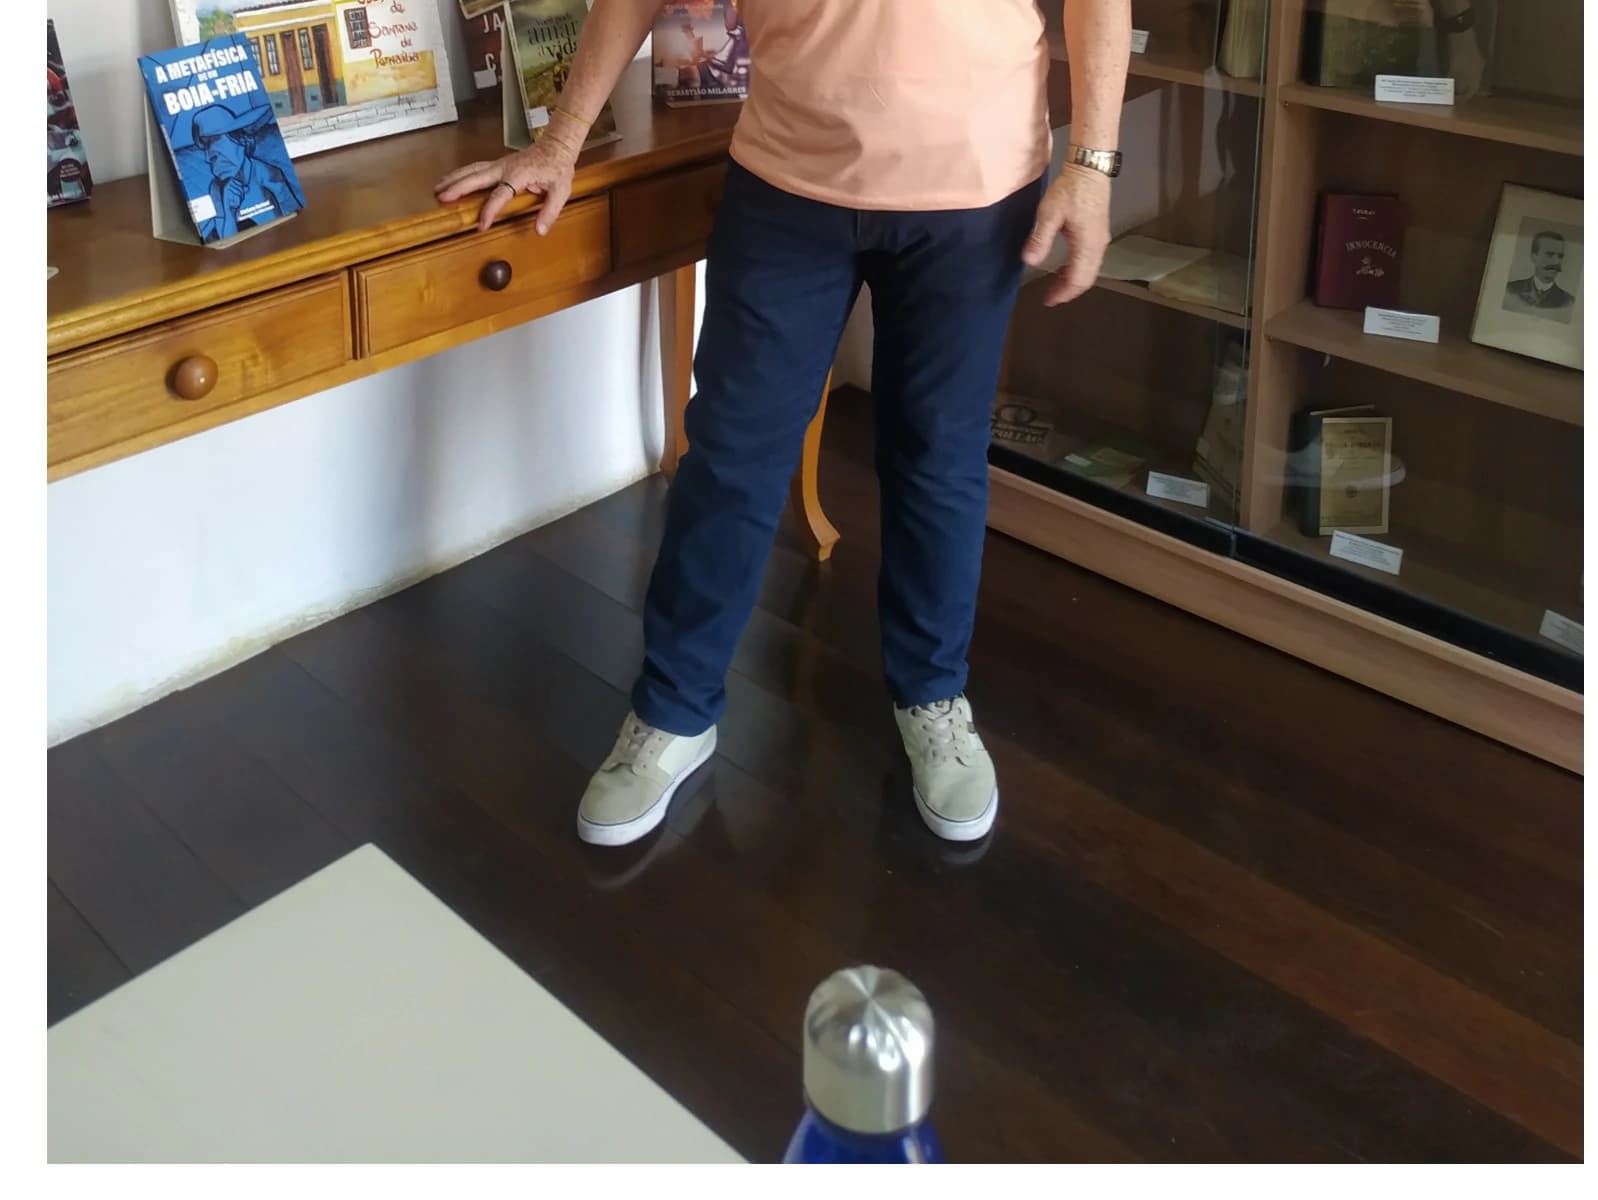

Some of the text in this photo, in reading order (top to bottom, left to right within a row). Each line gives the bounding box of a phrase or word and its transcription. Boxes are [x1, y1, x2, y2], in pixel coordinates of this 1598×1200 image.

[390, 0, 406, 14] de
[155, 44, 249, 84] A METAFÍSICA
[163, 70, 259, 116] BOIA-FRIA
